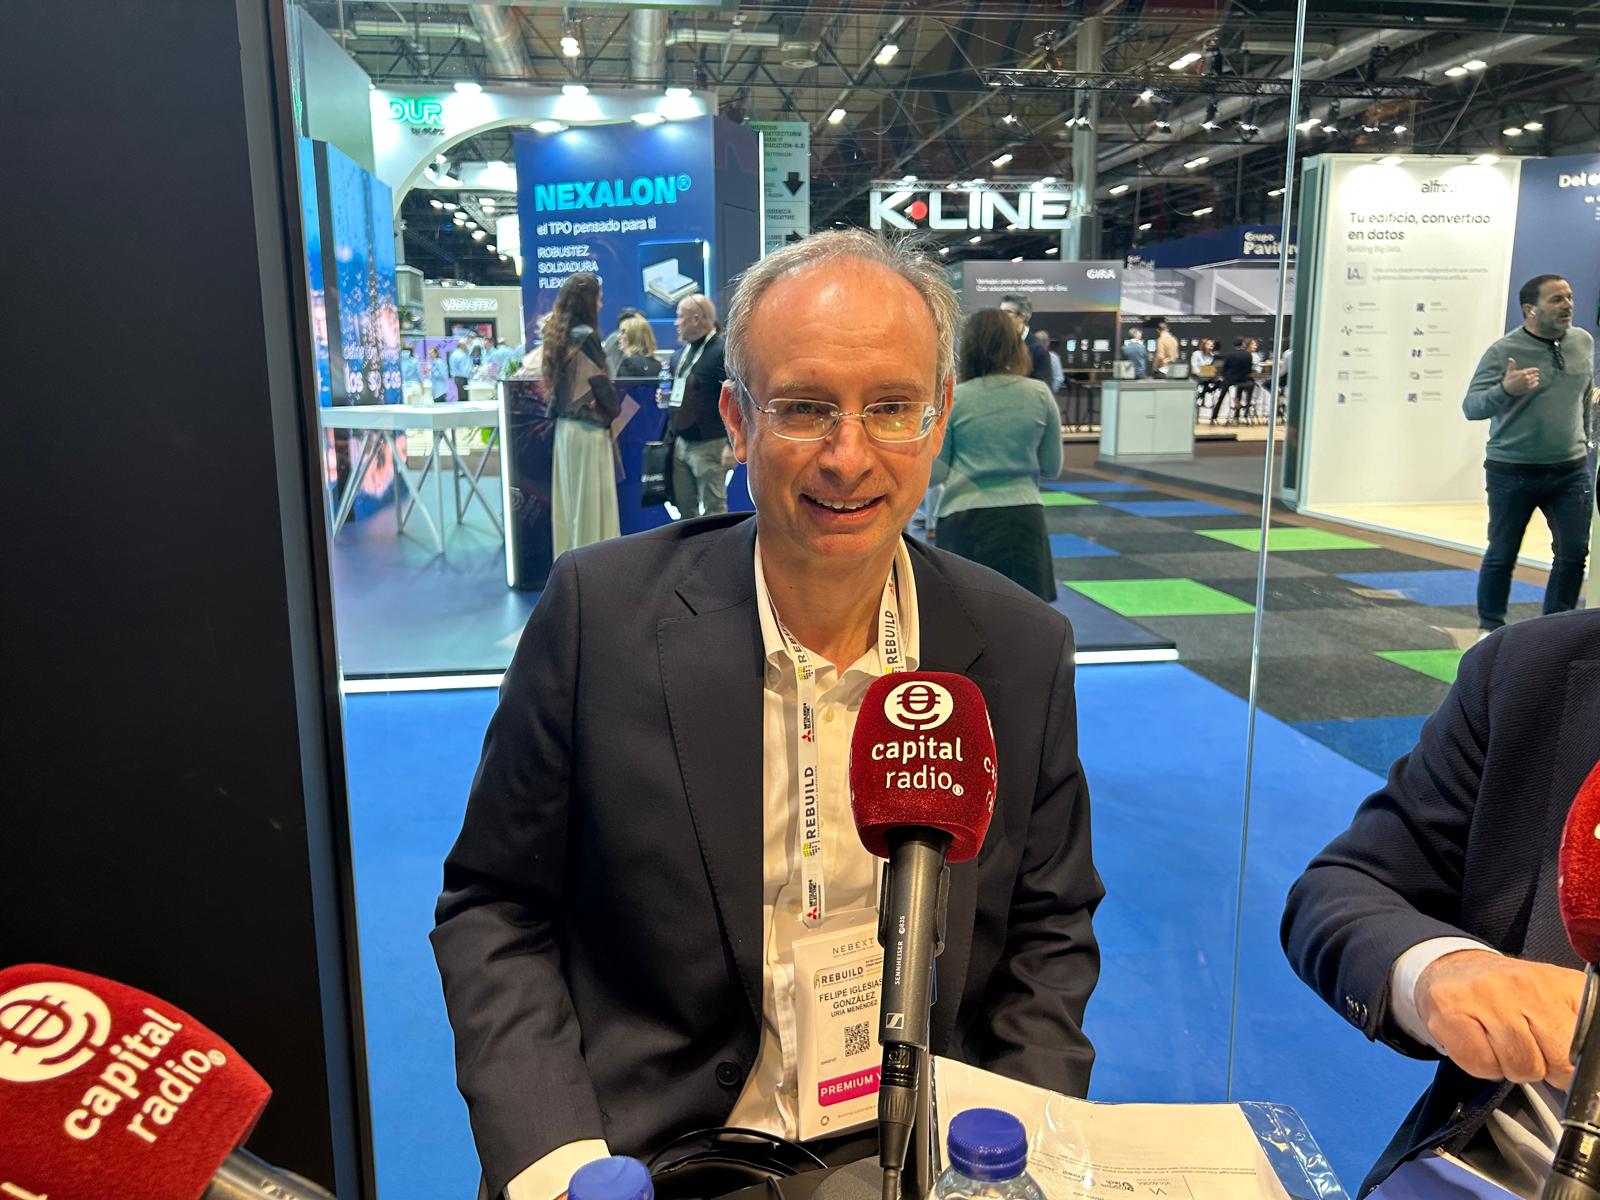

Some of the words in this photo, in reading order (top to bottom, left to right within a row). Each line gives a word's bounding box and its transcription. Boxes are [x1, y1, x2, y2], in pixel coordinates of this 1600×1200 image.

[536, 222, 548, 236] el
[550, 221, 572, 236] TPO
[573, 218, 621, 237] pensado
[621, 219, 646, 235] para
[1350, 212, 1365, 224] Tu
[1422, 212, 1491, 225] convertido
[1348, 230, 1365, 241] en
[1367, 228, 1405, 241] datos
[537, 244, 590, 259] ROBUSTEZ
[537, 261, 599, 274] SOLDADURA
[1087, 269, 1116, 280] GIRA
[884, 610, 899, 665] REBUILD
[871, 735, 964, 765] capital
[804, 766, 816, 840] REBUILD
[832, 937, 875, 955] NEBEXT
[894, 941, 904, 985] SENNHEISER
[821, 966, 864, 984] REBUILD
[819, 988, 848, 1003] FELIPE
[833, 990, 876, 1009] GONZÁLEZ
[64, 1007, 183, 1140] capital
[820, 1074, 874, 1097] PREMIUM
